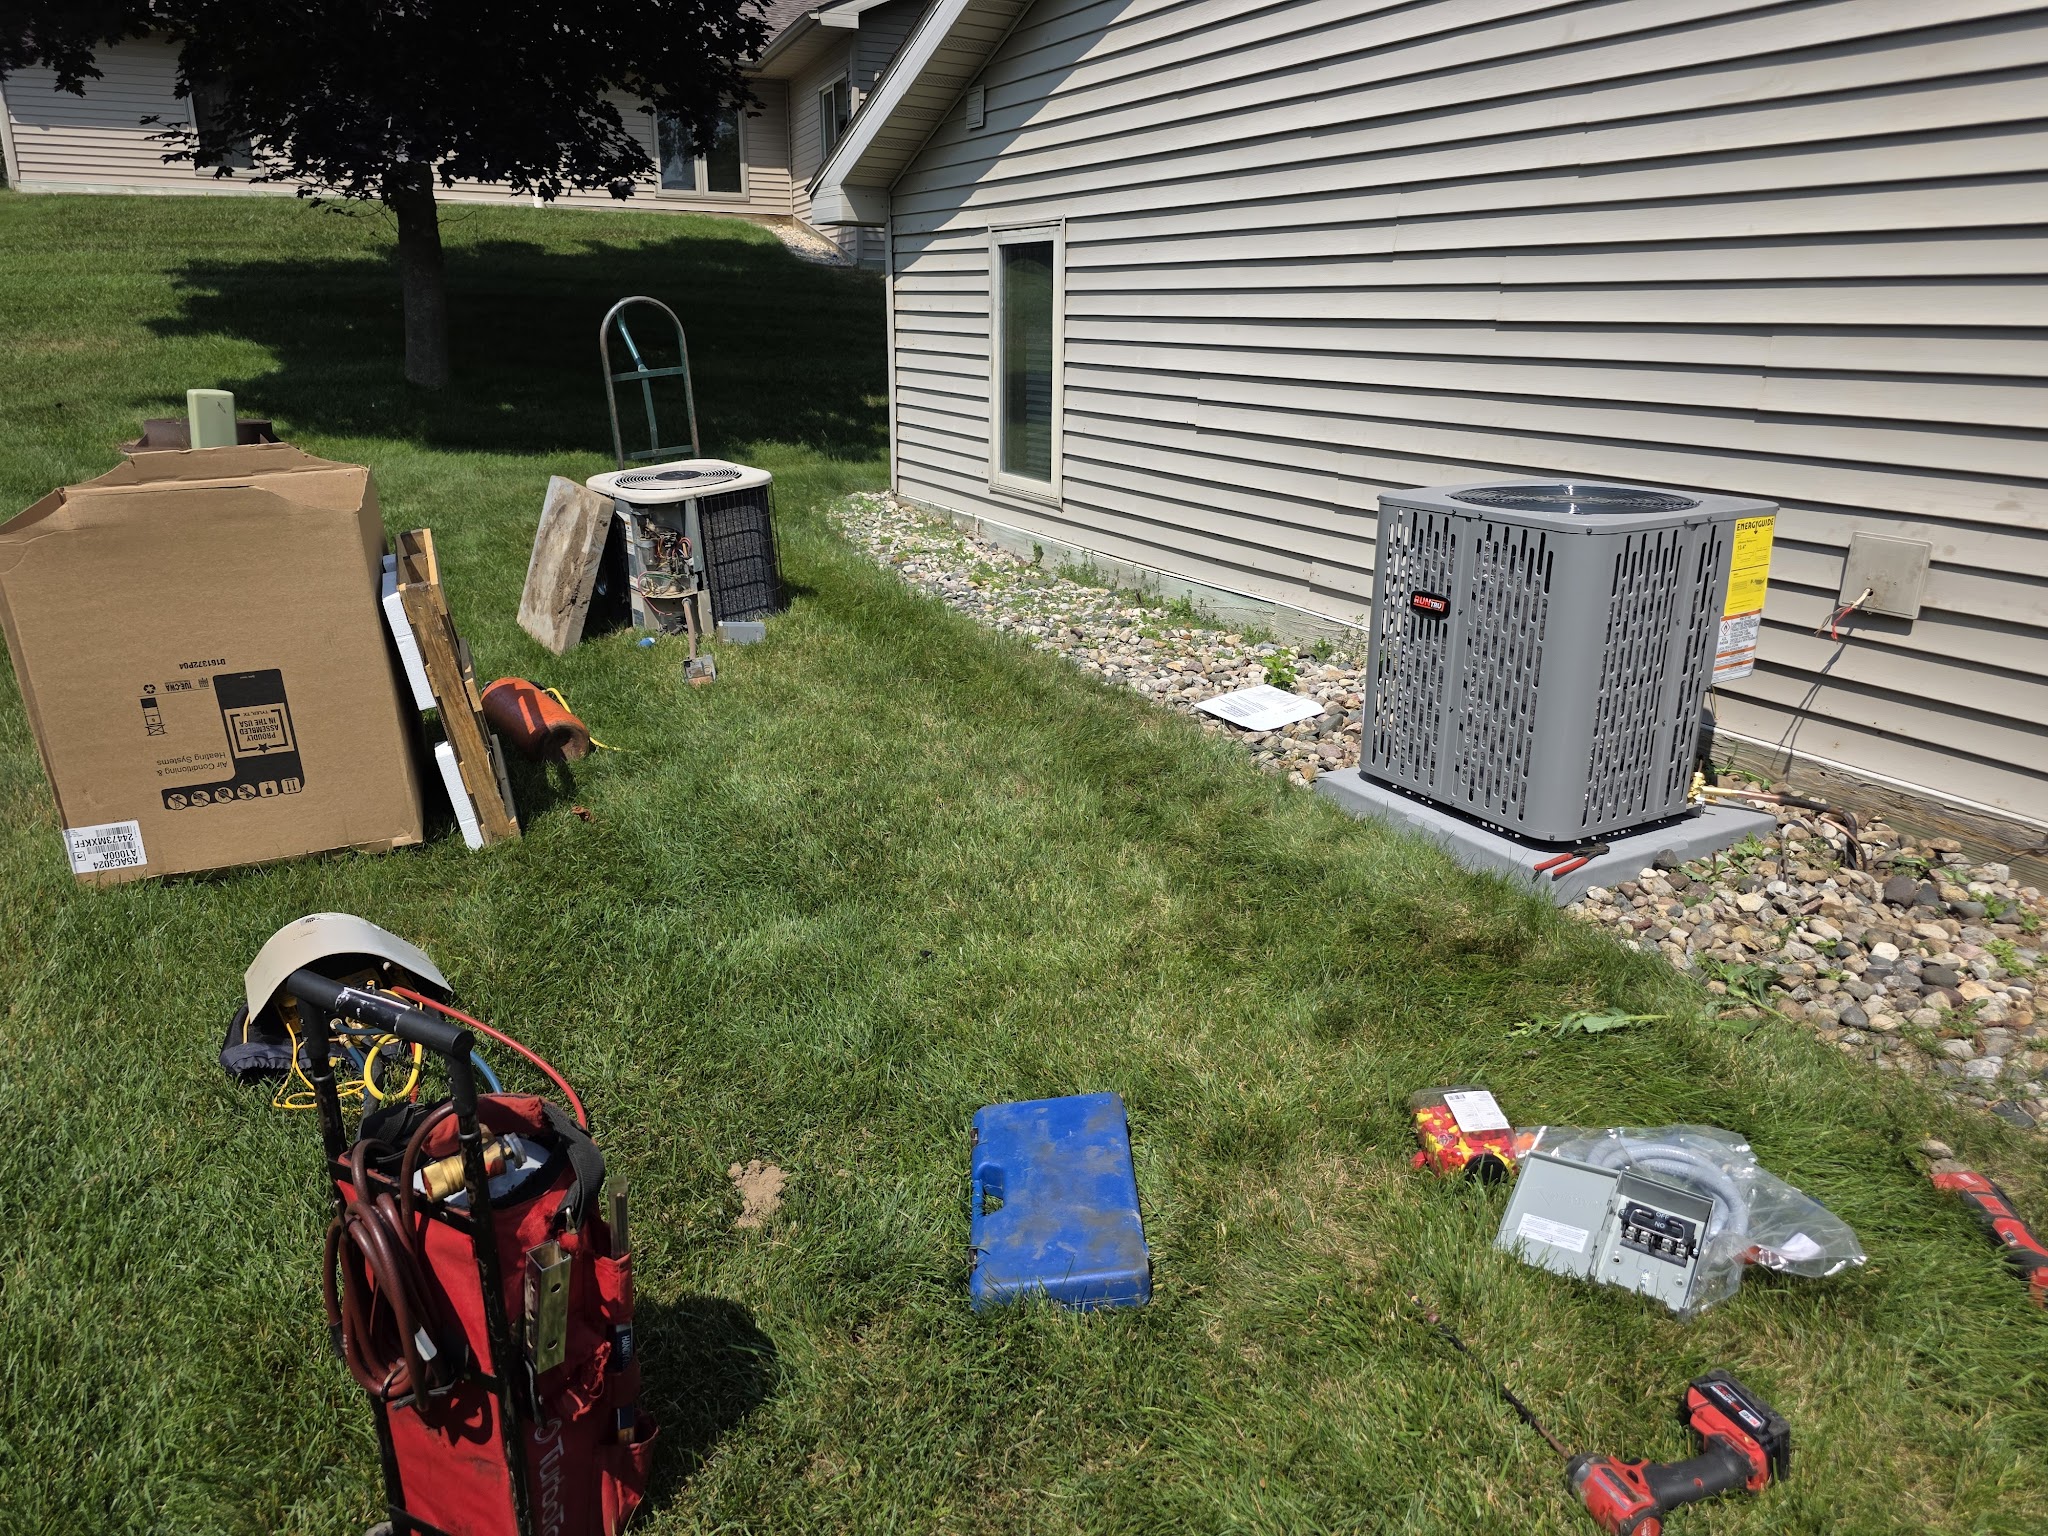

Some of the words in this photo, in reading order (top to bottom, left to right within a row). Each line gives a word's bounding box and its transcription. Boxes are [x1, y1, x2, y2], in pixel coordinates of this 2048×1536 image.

[239, 720, 253, 728] USA
[240, 724, 279, 735] ASSEMBLED
[247, 732, 276, 741] PROUDLY
[156, 756, 193, 765] Systems
[194, 752, 226, 761] Heating
[164, 762, 215, 774] Conditioning
[74, 833, 134, 848] 24473MXKFF
[102, 849, 137, 860] A1000A
[93, 856, 138, 869] A5AC3024
[1656, 1211, 1669, 1219] OFF
